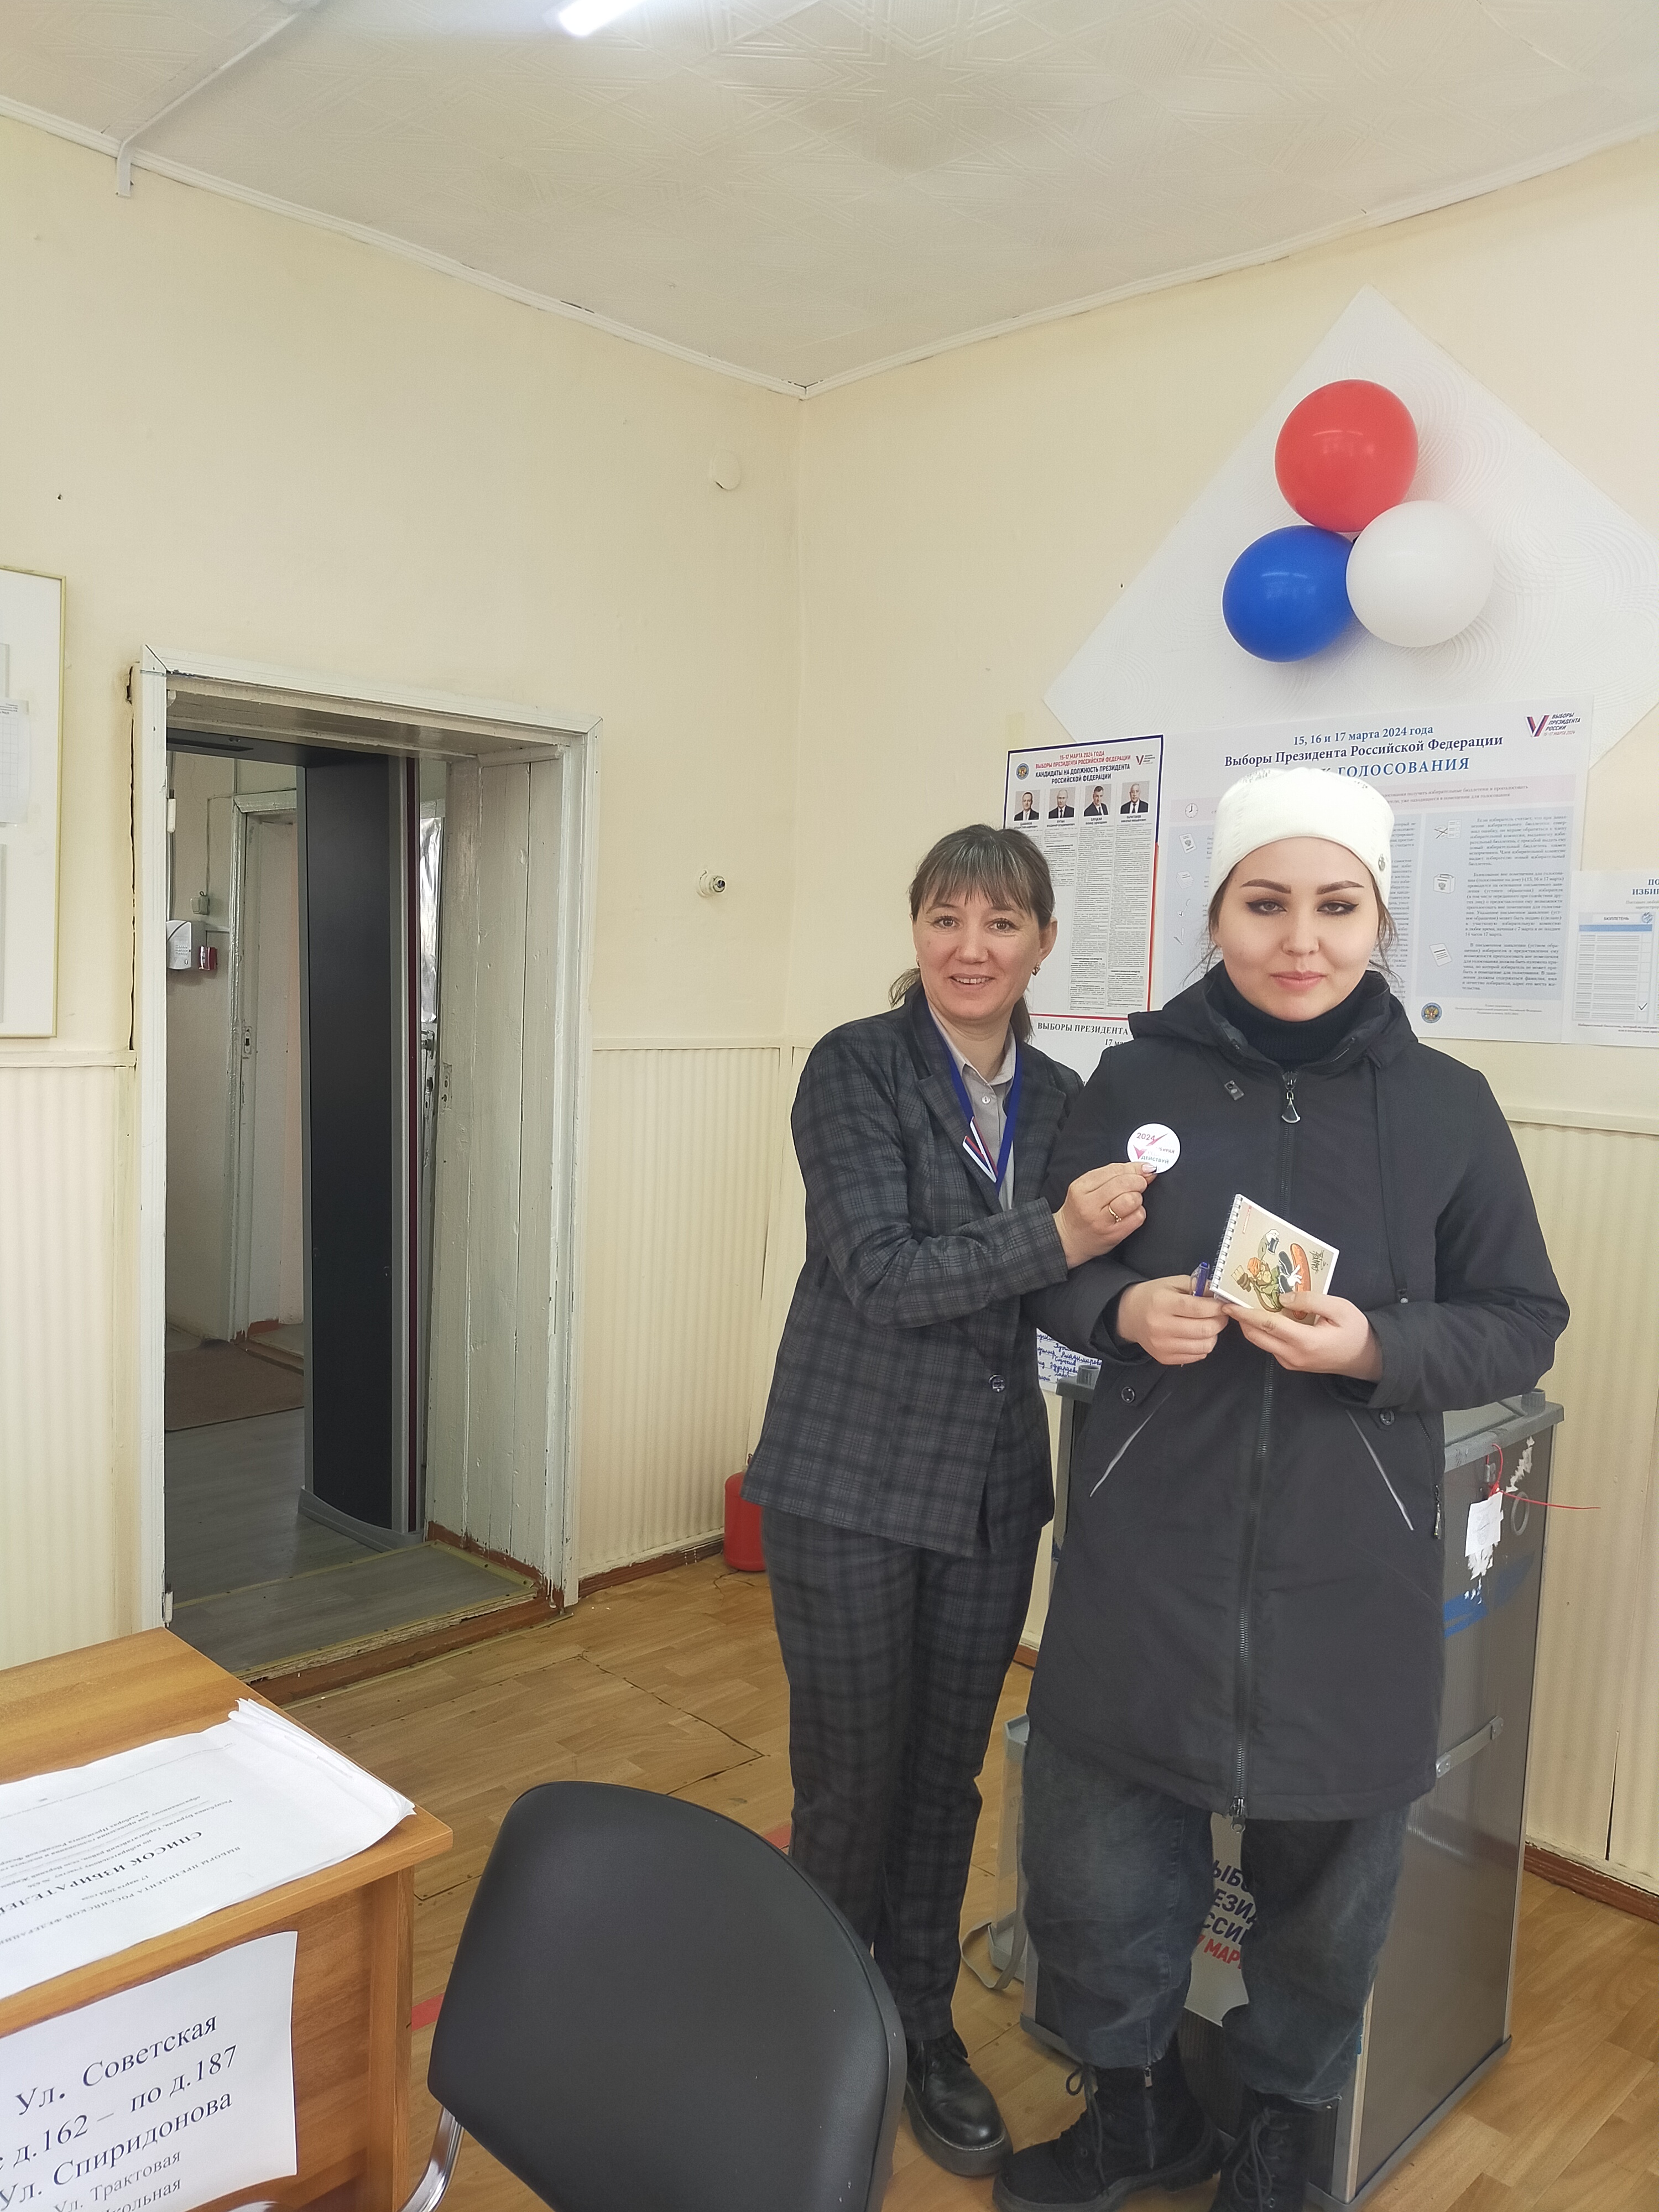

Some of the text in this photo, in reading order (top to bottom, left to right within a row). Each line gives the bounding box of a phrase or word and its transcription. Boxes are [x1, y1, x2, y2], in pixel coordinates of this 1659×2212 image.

[1293, 736, 1307, 746] 15,
[1311, 734, 1322, 744] 16
[1335, 732, 1346, 742] 17
[1348, 731, 1379, 742] марта
[1383, 727, 1407, 738] 2024
[1409, 726, 1433, 736] года
[1078, 757, 1104, 766] РОССИЙСКОЙ
[1105, 755, 1131, 764] ФЕДЕРАЦИИ
[1225, 736, 1503, 767] Выборы Президента Российской Федерации
[1051, 773, 1112, 784] РОССИЙСКОЙ ФЕДЕРАЦИИ
[1070, 766, 1099, 775] ДОЛЖНОСТЬ
[1099, 764, 1130, 772] ПРЕЗИДЕНТА
[1338, 757, 1470, 778] ГОЛОСОВАНИЯ
[1037, 1022, 1128, 1035] ВЫБОРЫ ПРЕЗИДЕНТА
[1141, 1156, 1169, 1164] ДЕЙСТВУЙ
[129, 1832, 202, 1866] СПИСОК
[1204, 1938, 1241, 1969] МАР
[15, 2015, 217, 2116] Ул. Советская
[13, 2114, 89, 2168] д.162
[130, 2086, 162, 2112] по
[169, 2044, 237, 2098] д.187
[0, 2093, 233, 2211] Ул. Спиридонова
[90, 2151, 181, 2201] Трактовая
